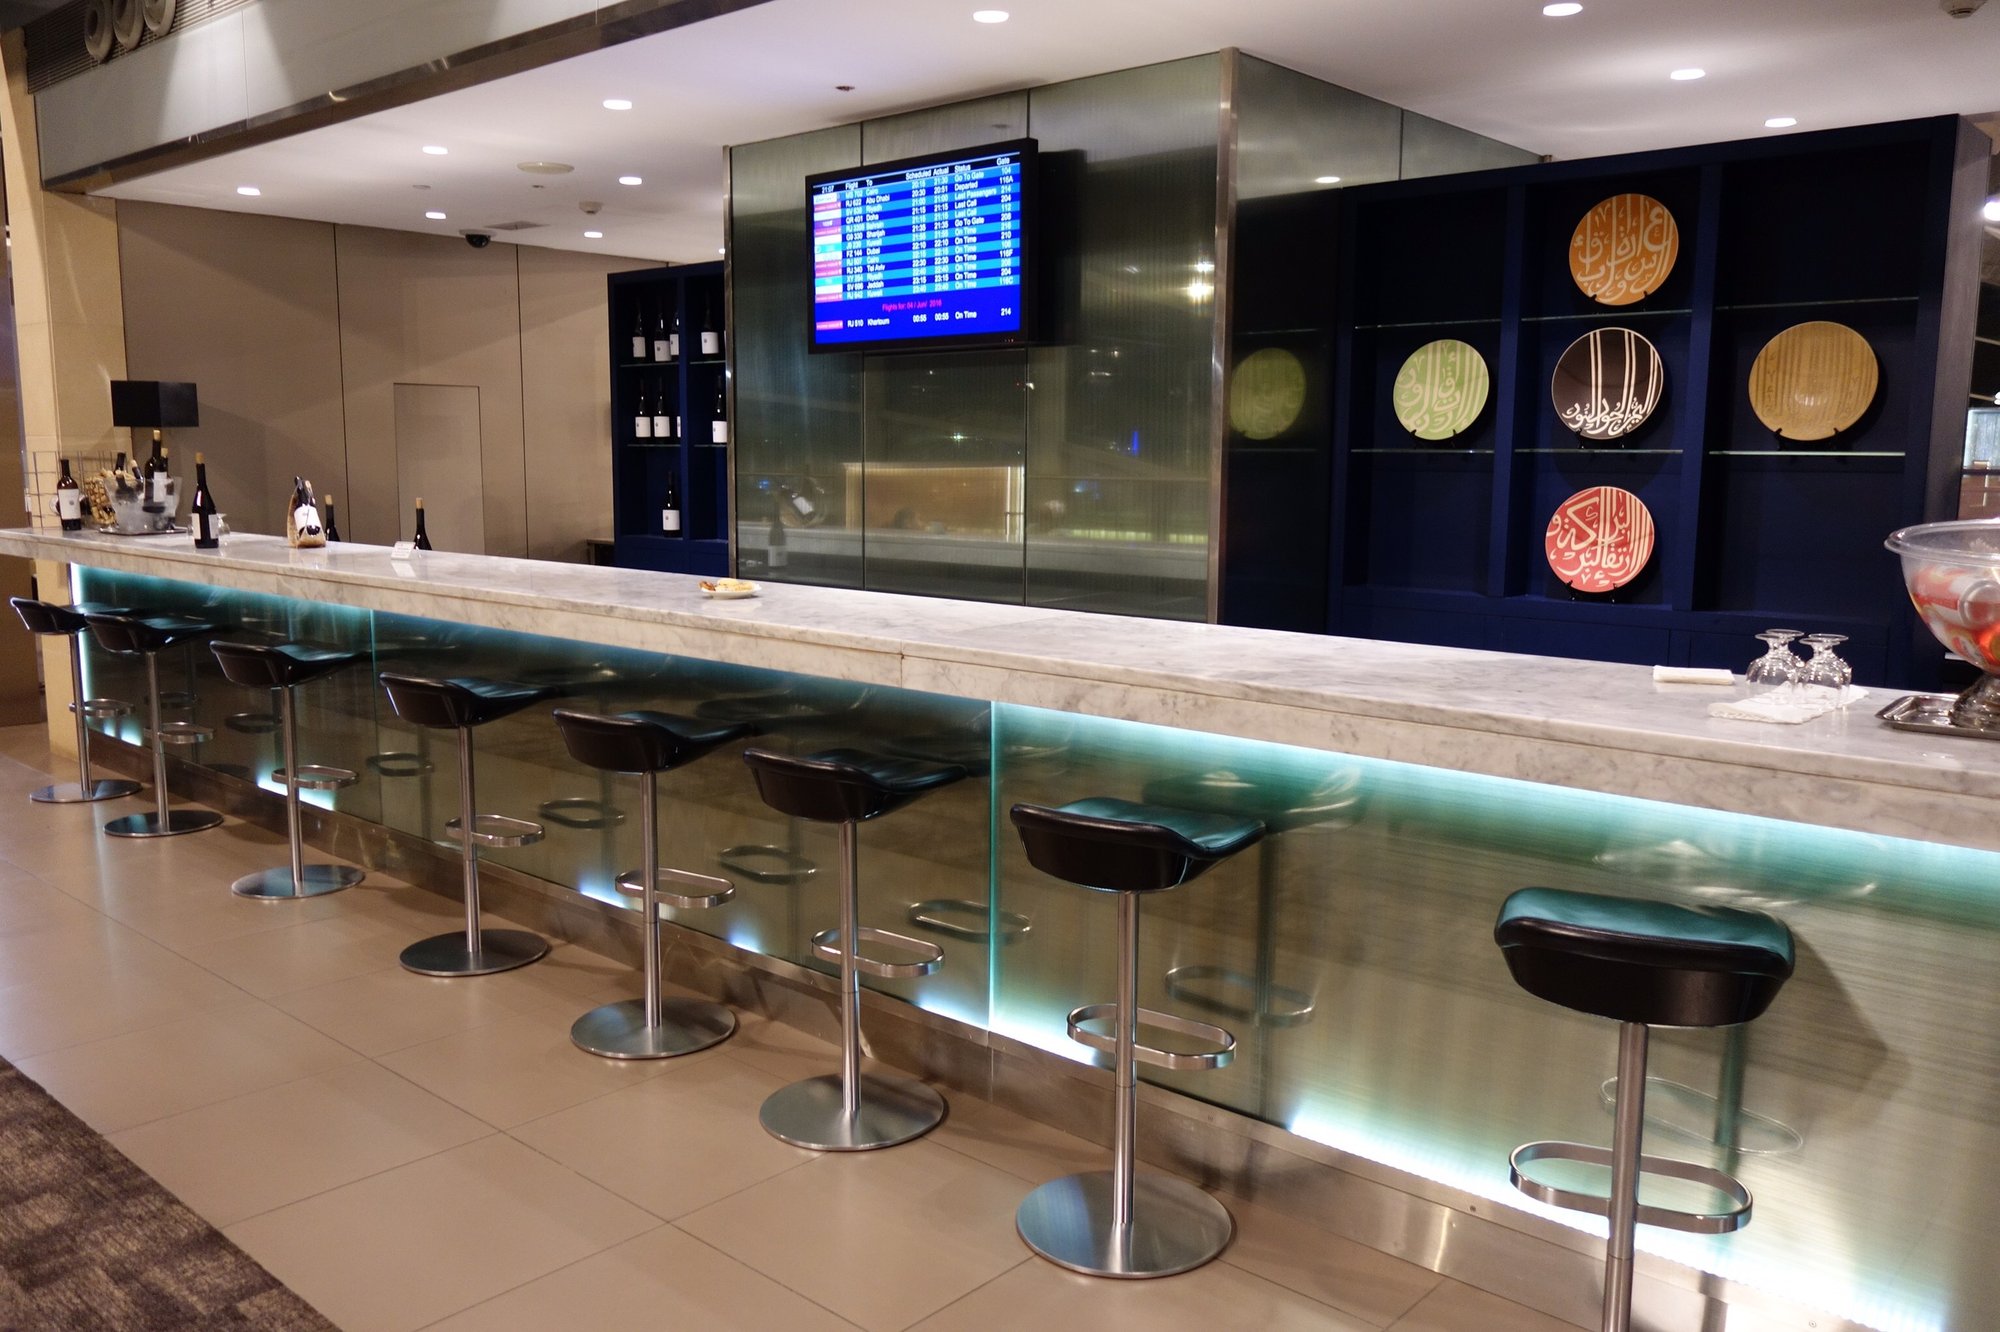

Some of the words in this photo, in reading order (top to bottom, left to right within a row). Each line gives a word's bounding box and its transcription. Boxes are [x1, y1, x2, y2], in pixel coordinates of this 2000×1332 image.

[866, 179, 873, 187] To
[933, 166, 949, 176] Actual
[997, 157, 1010, 166] Gate
[955, 311, 964, 319] On
[964, 310, 977, 318] Time
[1001, 308, 1011, 316] 214
